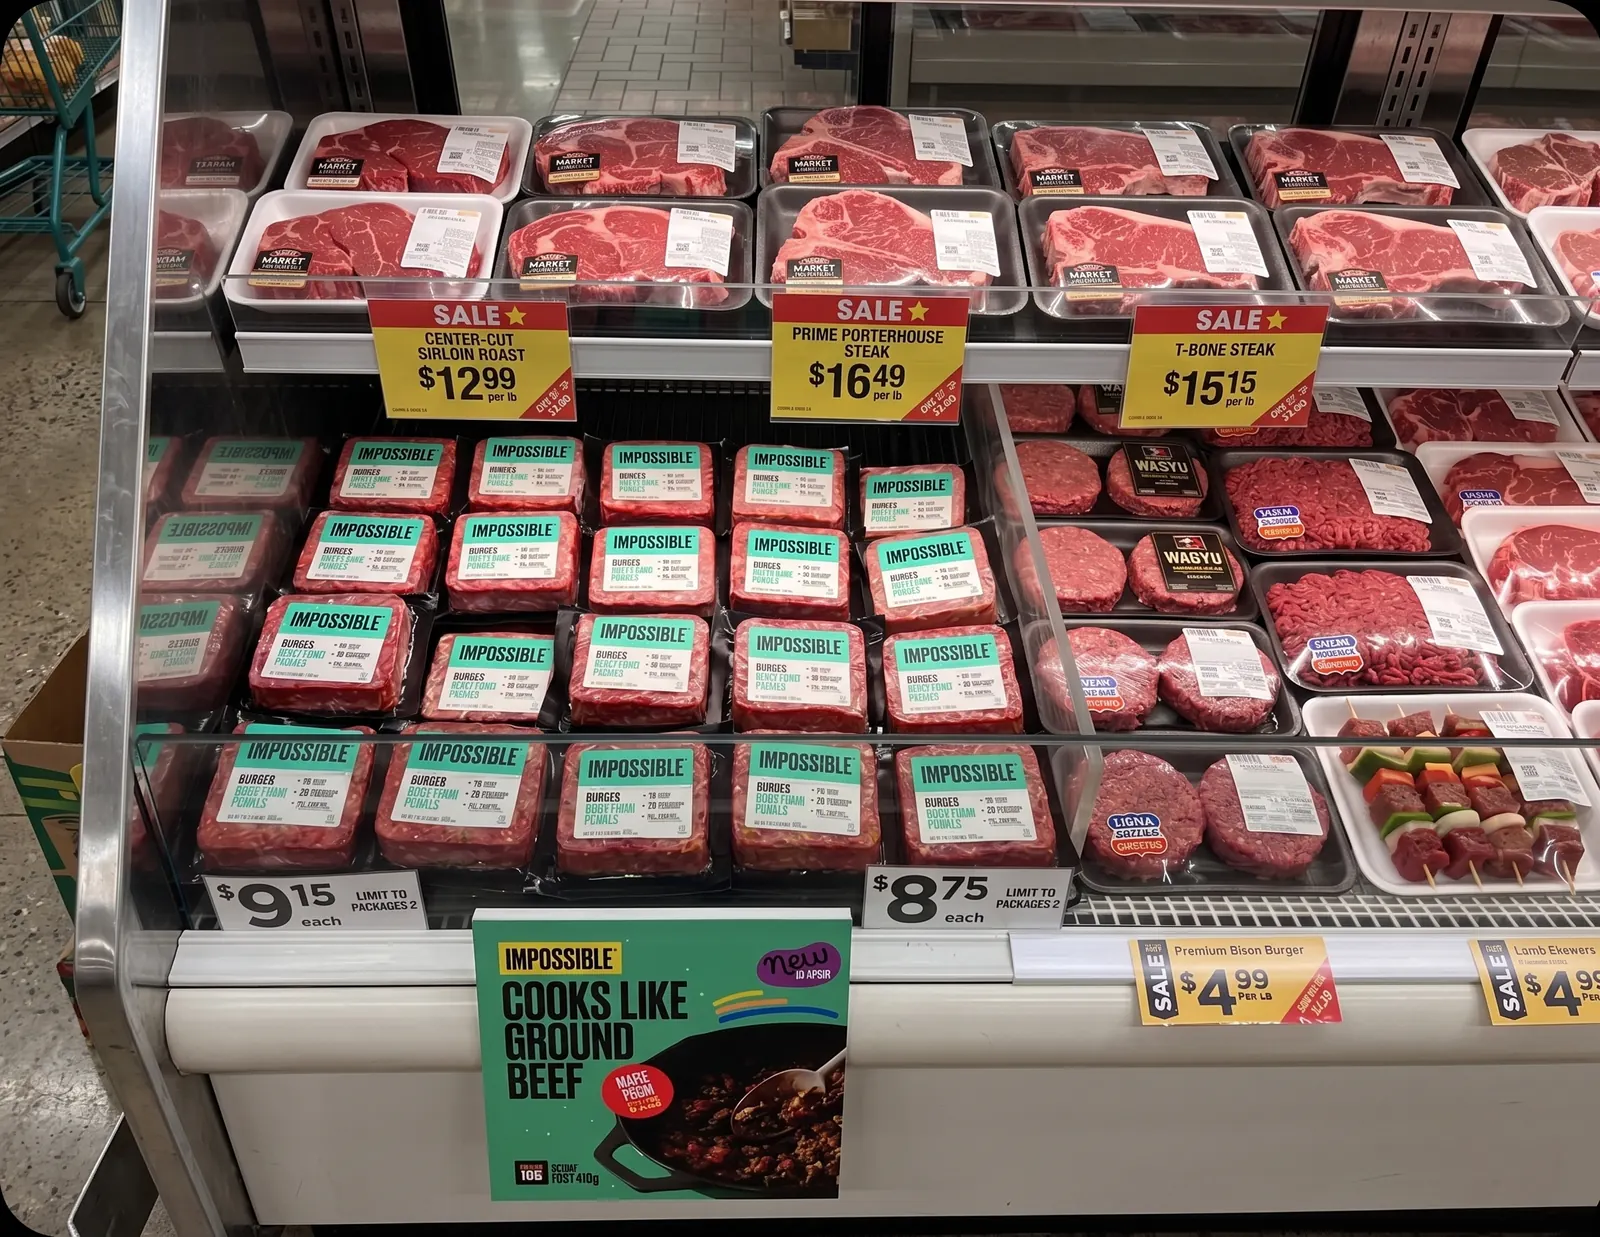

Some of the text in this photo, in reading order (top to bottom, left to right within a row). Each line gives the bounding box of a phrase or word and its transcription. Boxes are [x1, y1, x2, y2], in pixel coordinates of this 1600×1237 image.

[556, 157, 594, 166] MARKET
[794, 159, 832, 168] MARKET
[262, 257, 306, 265] MARKET
[529, 260, 571, 268] MARKET
[794, 264, 835, 272] MARKET
[1069, 271, 1112, 279] MARKET
[1335, 276, 1377, 284] MARKET
[433, 304, 500, 326] SALE
[837, 299, 903, 321] SALE
[1196, 309, 1263, 331] SALE
[425, 332, 514, 347] CENTER-CUT
[792, 327, 944, 344] PRIME PORTERHOUSE
[418, 347, 525, 361] SIRLOIN ROAST
[844, 345, 890, 358] STEAK
[1175, 343, 1276, 357] T-BONE STEAK
[488, 392, 517, 403] per lb
[873, 390, 902, 401] per lb
[1226, 396, 1254, 408] per lb
[358, 447, 434, 461] IMPOSSIBLE
[493, 445, 567, 458] IMPOSSIBLE
[619, 451, 694, 464] IMPOSSIBLE
[755, 453, 827, 468] IMPOSSIBLE
[1134, 460, 1189, 473] WASYU
[873, 479, 945, 494] IMPOSSIBLE
[330, 523, 412, 539] IMPOSSIBLE
[472, 524, 551, 538] IMPOSSIBLE
[614, 535, 693, 549] IMPOSSIBLE
[755, 538, 832, 556] IMPOSSIBLE
[886, 541, 966, 565] IMPOSSIBLE
[1163, 551, 1223, 564] WAGYU
[290, 611, 380, 631] IMPOSSIBLE
[600, 623, 686, 643] IMPOSSIBLE
[757, 636, 842, 655] IMPOSSIBLE
[459, 644, 546, 663] IMPOSSIBLE
[904, 644, 990, 663] IMPOSSIBLE
[248, 742, 347, 764] IMPOSSIBLE
[419, 743, 517, 767] IMPOSSIBLE
[588, 758, 684, 778] IMPOSSIBLE
[760, 750, 852, 775] IMPOSSIBLE
[921, 764, 1016, 784] IMPOSSIBLE
[586, 792, 621, 802] BURGES
[925, 797, 960, 807] BURGES
[356, 889, 408, 901] LIMIT TO
[1006, 888, 1056, 897] LIMIT TO
[352, 900, 418, 912] PACKAGES 2
[996, 900, 1060, 909] PACKAGES 2
[302, 916, 342, 927] each
[945, 912, 984, 922] each
[1174, 945, 1227, 956] Premium
[1230, 945, 1261, 956] Bison
[1265, 945, 1304, 957] Burger
[1514, 946, 1547, 956] Lamb
[1549, 946, 1596, 955] Ekewers
[505, 948, 613, 970] IMPOSSIBLE
[763, 948, 828, 975] new
[1148, 954, 1172, 1012] SALE
[1489, 955, 1520, 1012] SALE
[502, 981, 688, 1021] COOKS LIKE
[1238, 991, 1273, 1001] PER LB
[505, 1023, 633, 1060] GROUND
[508, 1063, 583, 1099] BEEF
[615, 1070, 650, 1089] MARE
[552, 1173, 599, 1186] FOST 410g
